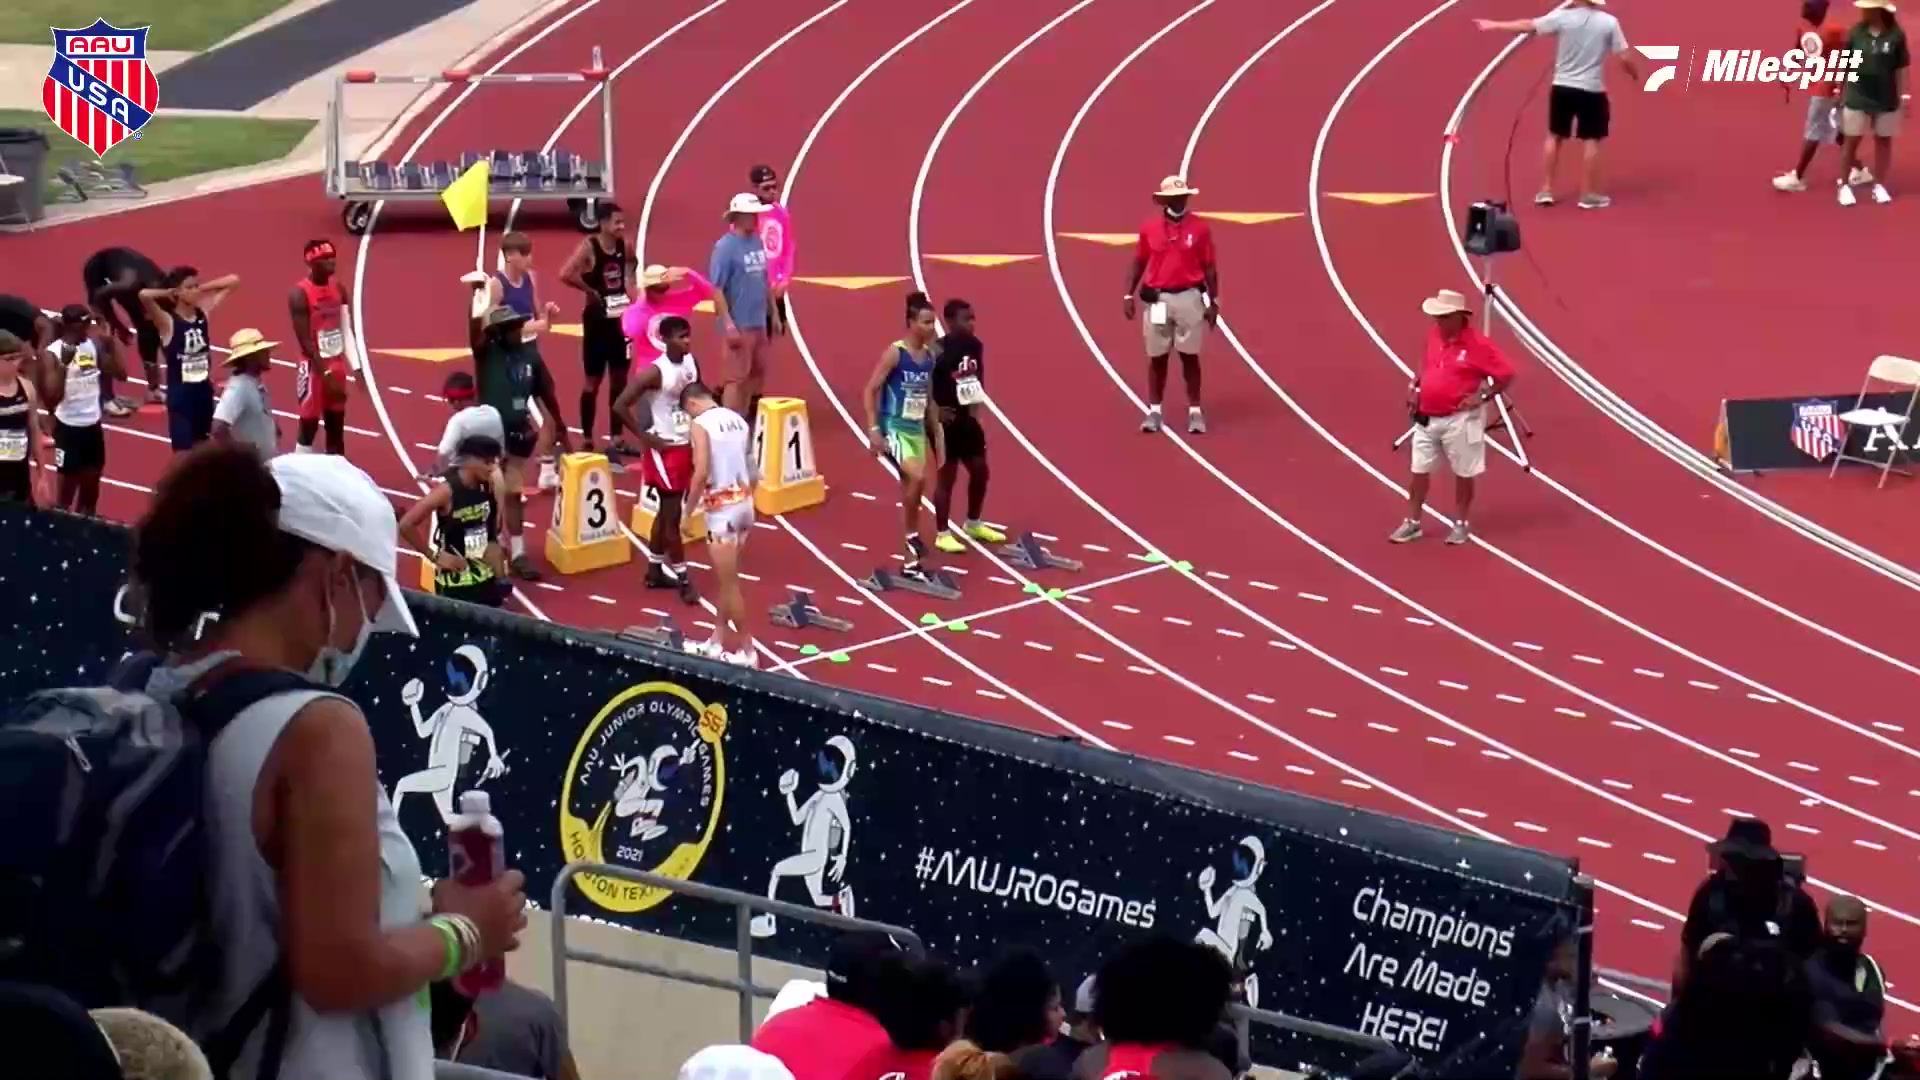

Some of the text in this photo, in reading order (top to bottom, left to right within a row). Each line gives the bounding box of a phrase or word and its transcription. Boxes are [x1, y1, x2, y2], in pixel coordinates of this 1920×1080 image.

[788, 431, 802, 470] 1
[1800, 420, 1833, 453] USA
[586, 488, 607, 528] 3
[601, 703, 646, 746] JUNIOR
[650, 700, 700, 738] OLYMPIC
[698, 743, 713, 807] GAMES
[616, 845, 644, 862] 2021
[915, 846, 1157, 929] #AAUJROGames
[1353, 887, 1516, 957] Champions
[1343, 942, 1492, 1008] Are Made
[1359, 1001, 1449, 1052] HERE!
